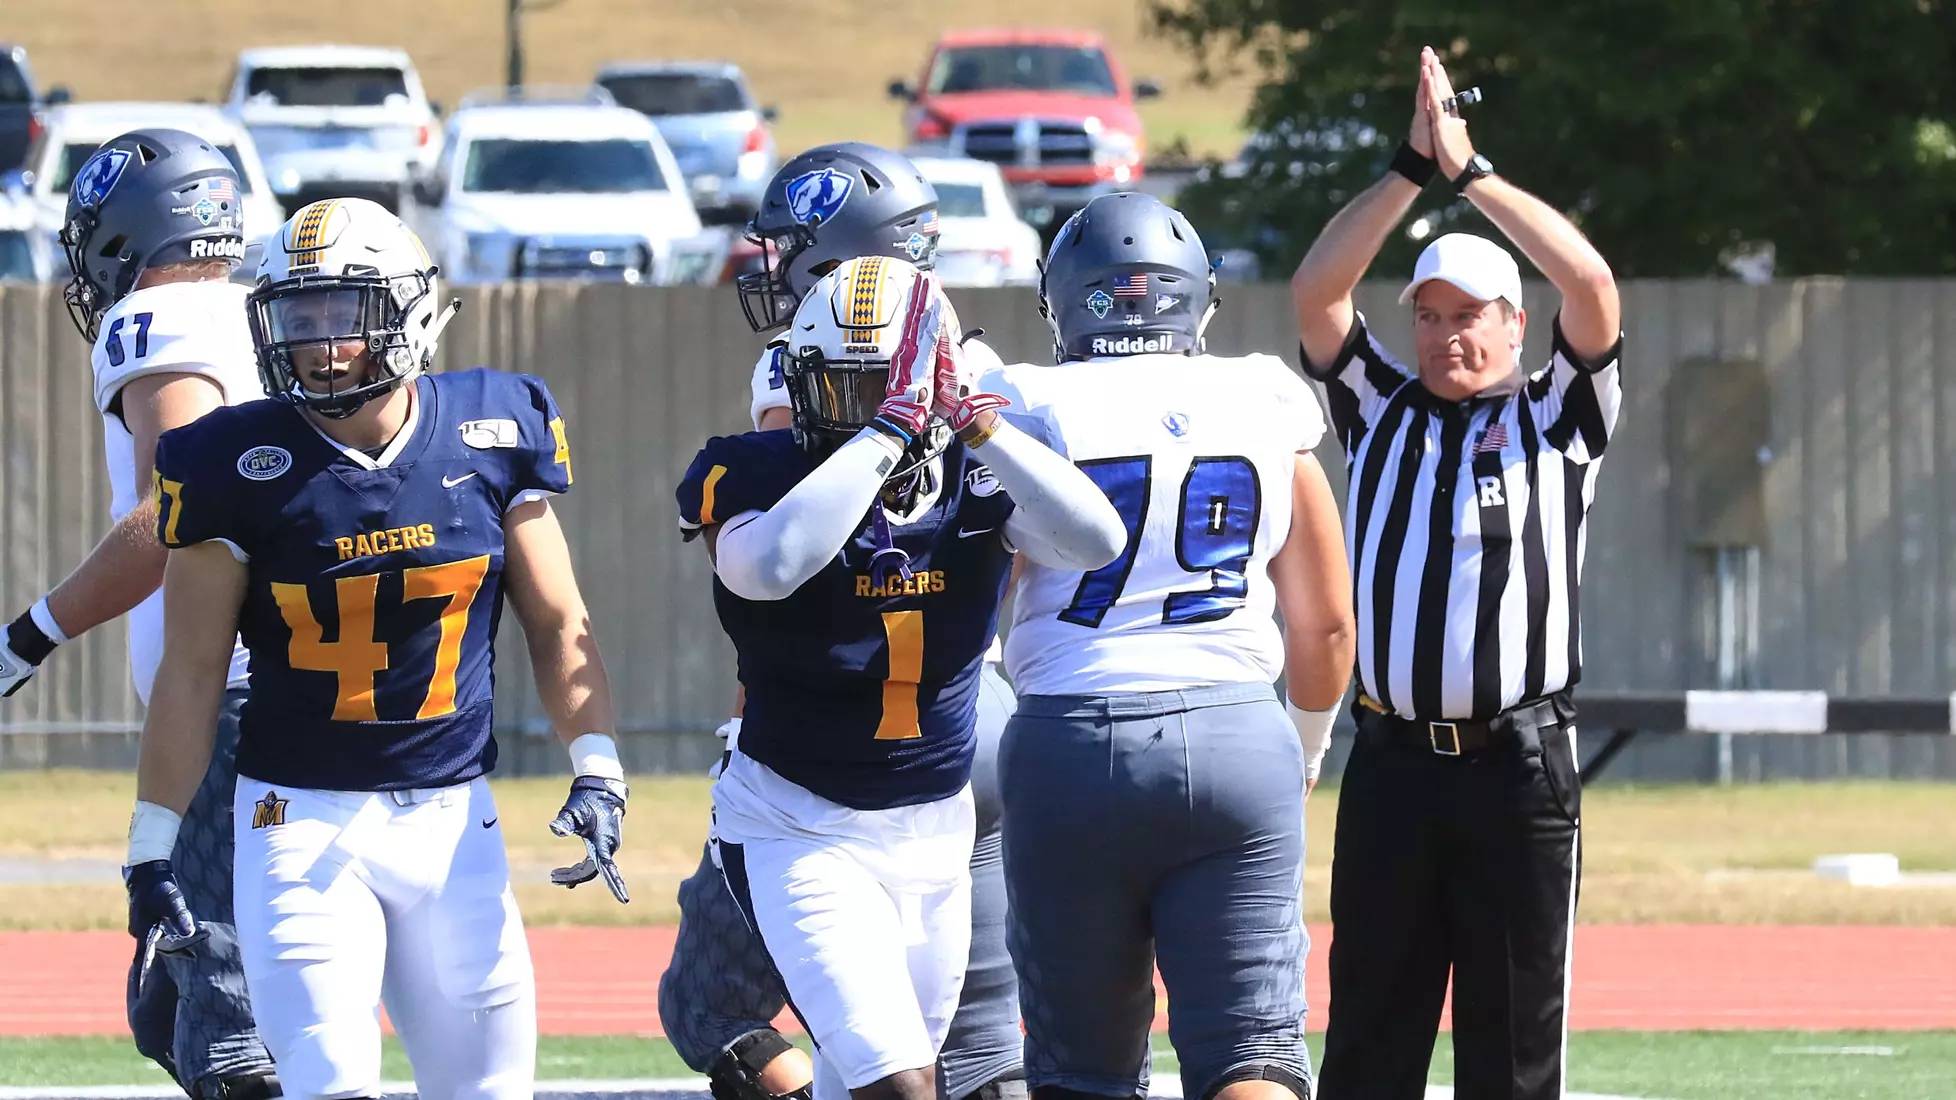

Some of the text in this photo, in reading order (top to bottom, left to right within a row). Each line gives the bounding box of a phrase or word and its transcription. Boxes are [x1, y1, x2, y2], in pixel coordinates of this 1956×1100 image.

[105, 312, 153, 367] 67
[846, 345, 879, 354] SPEED
[1092, 335, 1173, 354] Riddell
[251, 455, 276, 470] OVC
[1477, 475, 1505, 508] R
[334, 523, 436, 560] RACERS
[1057, 454, 1262, 628] 79
[855, 570, 945, 597] RACERS
[270, 553, 490, 722] 47
[873, 609, 924, 739] 1
